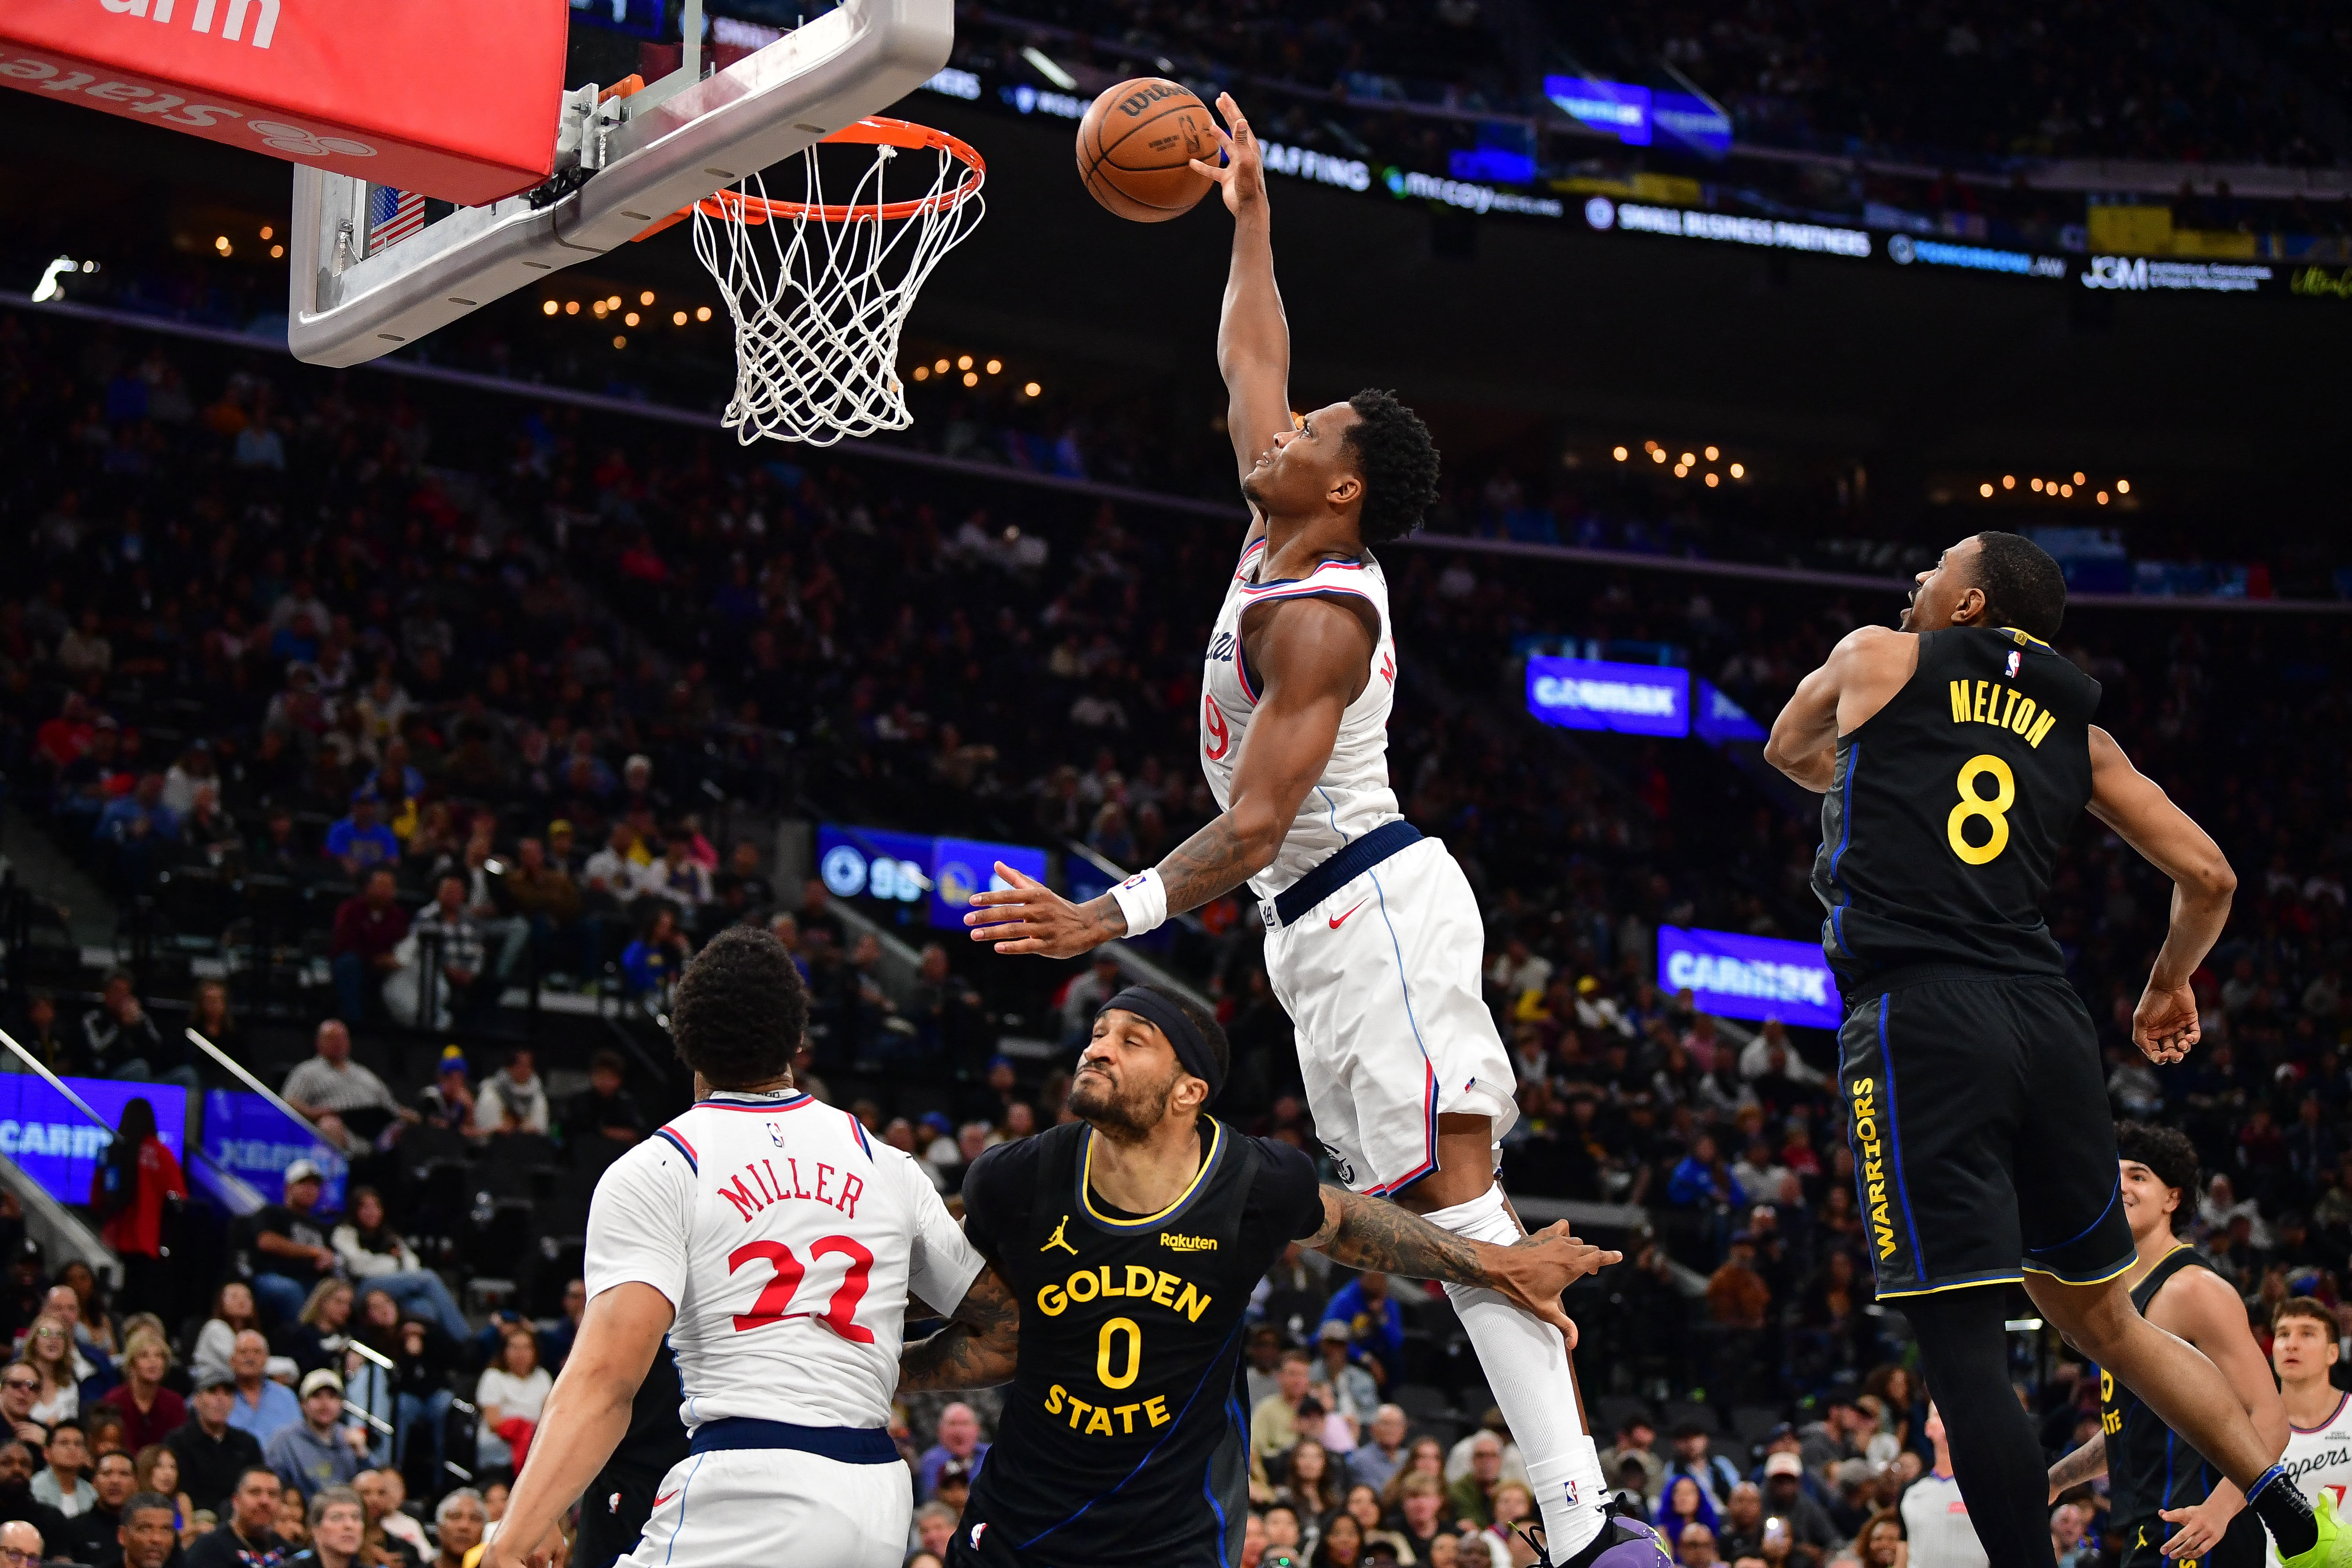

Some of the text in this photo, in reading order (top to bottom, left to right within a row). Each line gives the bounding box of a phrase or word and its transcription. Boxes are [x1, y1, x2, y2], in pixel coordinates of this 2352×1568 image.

[1950, 679, 2056, 749] MELTON
[1948, 754, 2015, 865] 8
[717, 1157, 863, 1223] MILLER
[1853, 1077, 1896, 1261] WARRIORS
[1160, 1232, 1217, 1251] Rakuten
[728, 1235, 874, 1344] 22
[1037, 1265, 1211, 1323] GOLDEN
[1096, 1317, 1141, 1389] 0
[1045, 1384, 1170, 1436] STATE
